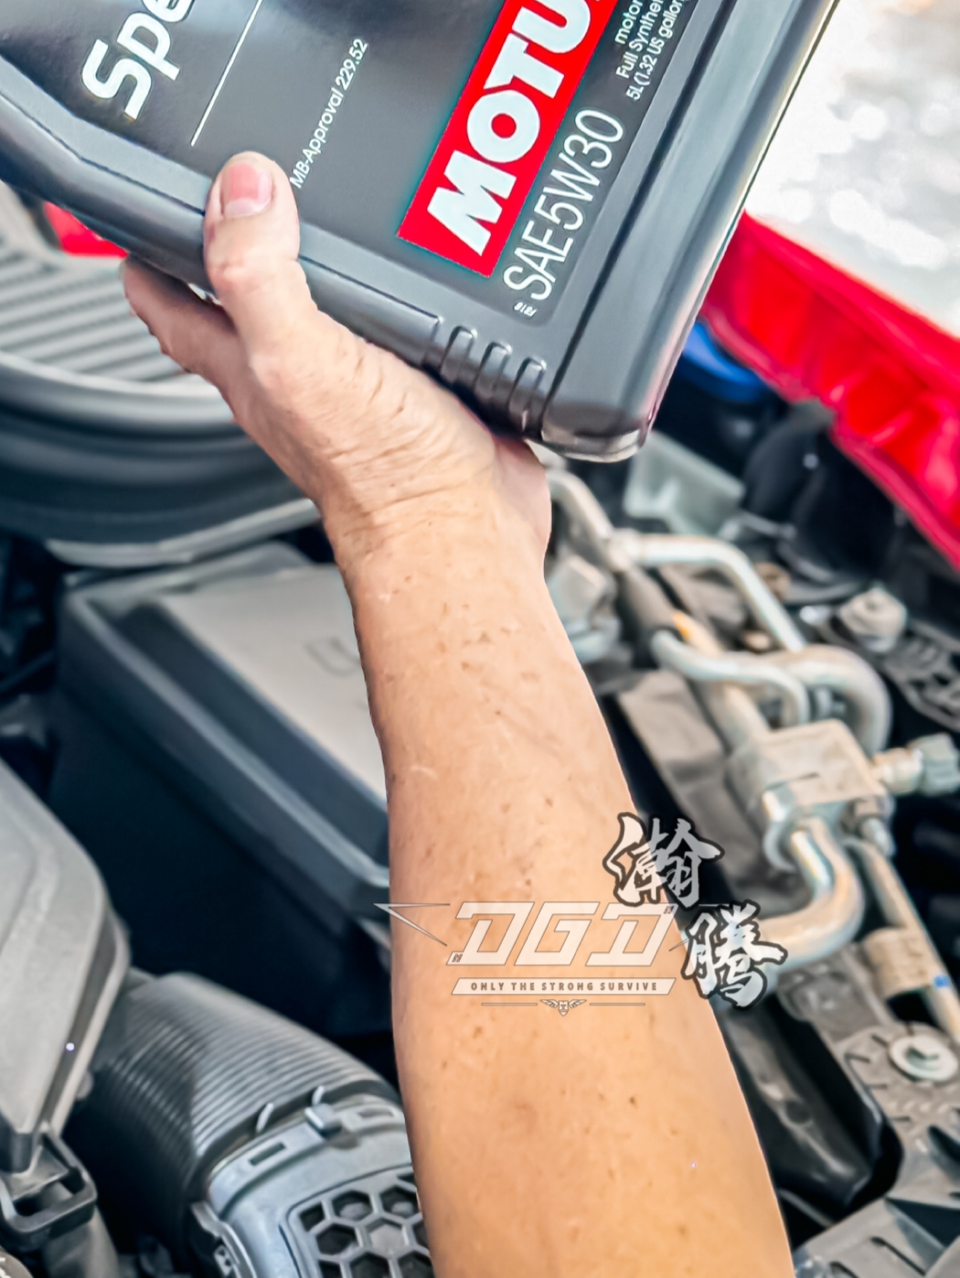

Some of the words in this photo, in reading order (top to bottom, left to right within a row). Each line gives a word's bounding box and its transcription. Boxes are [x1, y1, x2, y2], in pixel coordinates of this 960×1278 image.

[646, 37, 665, 55] US
[615, 52, 638, 79] Full
[289, 87, 344, 189] MB-Approval
[335, 38, 369, 91] 229.52
